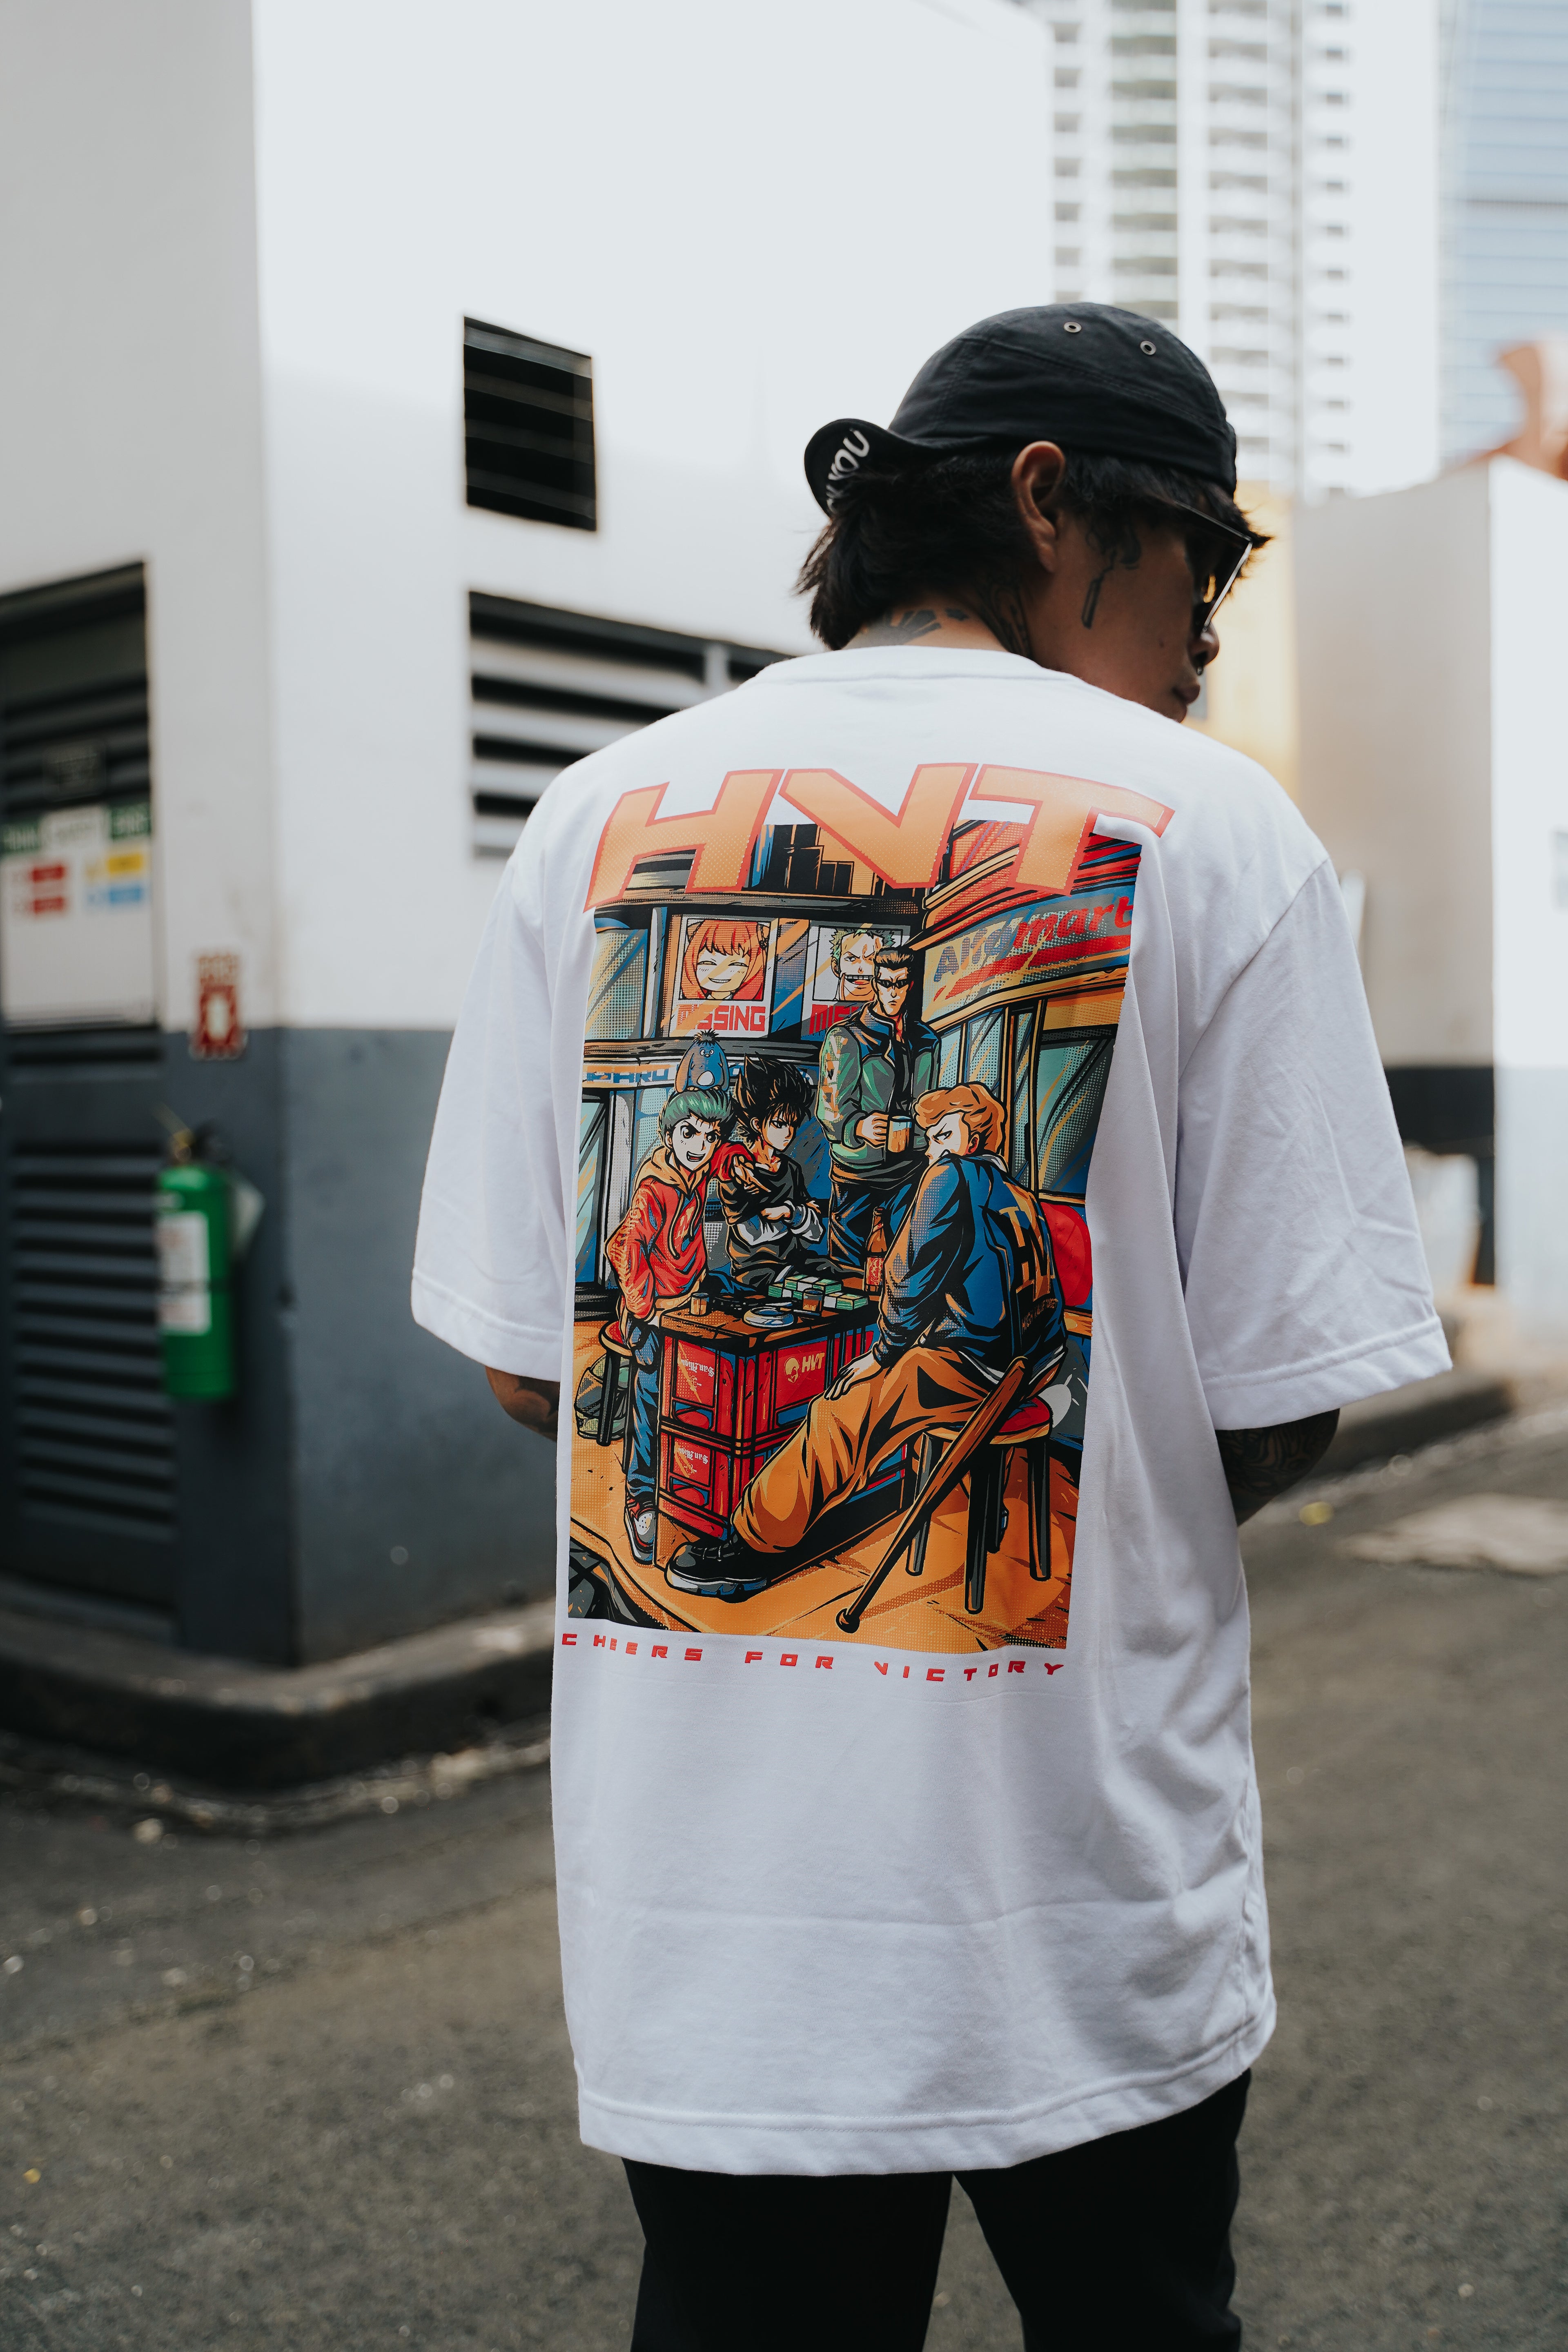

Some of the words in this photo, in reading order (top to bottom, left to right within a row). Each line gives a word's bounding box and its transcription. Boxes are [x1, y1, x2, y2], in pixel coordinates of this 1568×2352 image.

[809, 1004, 859, 1034] MIS
[802, 1352, 825, 1373] HVT
[562, 1633, 703, 1661] CHEERS
[745, 1651, 834, 1669] FOR
[874, 1660, 1064, 1682] VICTORY
